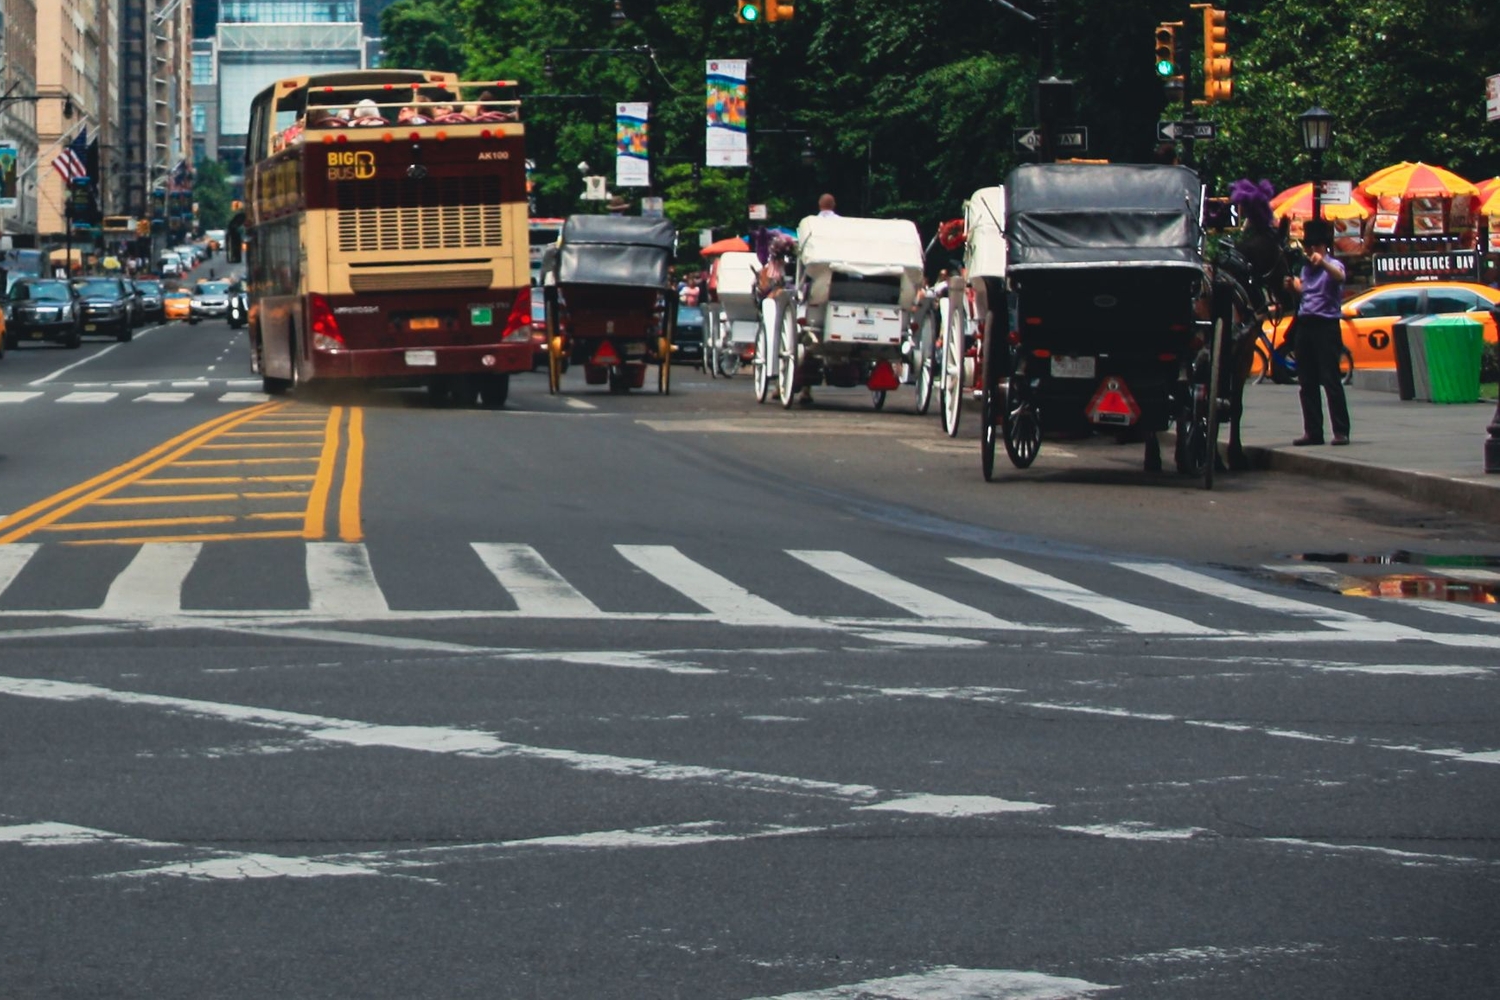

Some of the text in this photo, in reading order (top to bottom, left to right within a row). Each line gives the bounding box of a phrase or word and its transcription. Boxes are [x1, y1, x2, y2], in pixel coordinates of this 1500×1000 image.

[327, 151, 354, 166] BIG
[328, 167, 354, 180] BUS
[1377, 255, 1475, 272] INDEPENDENCE DAY
